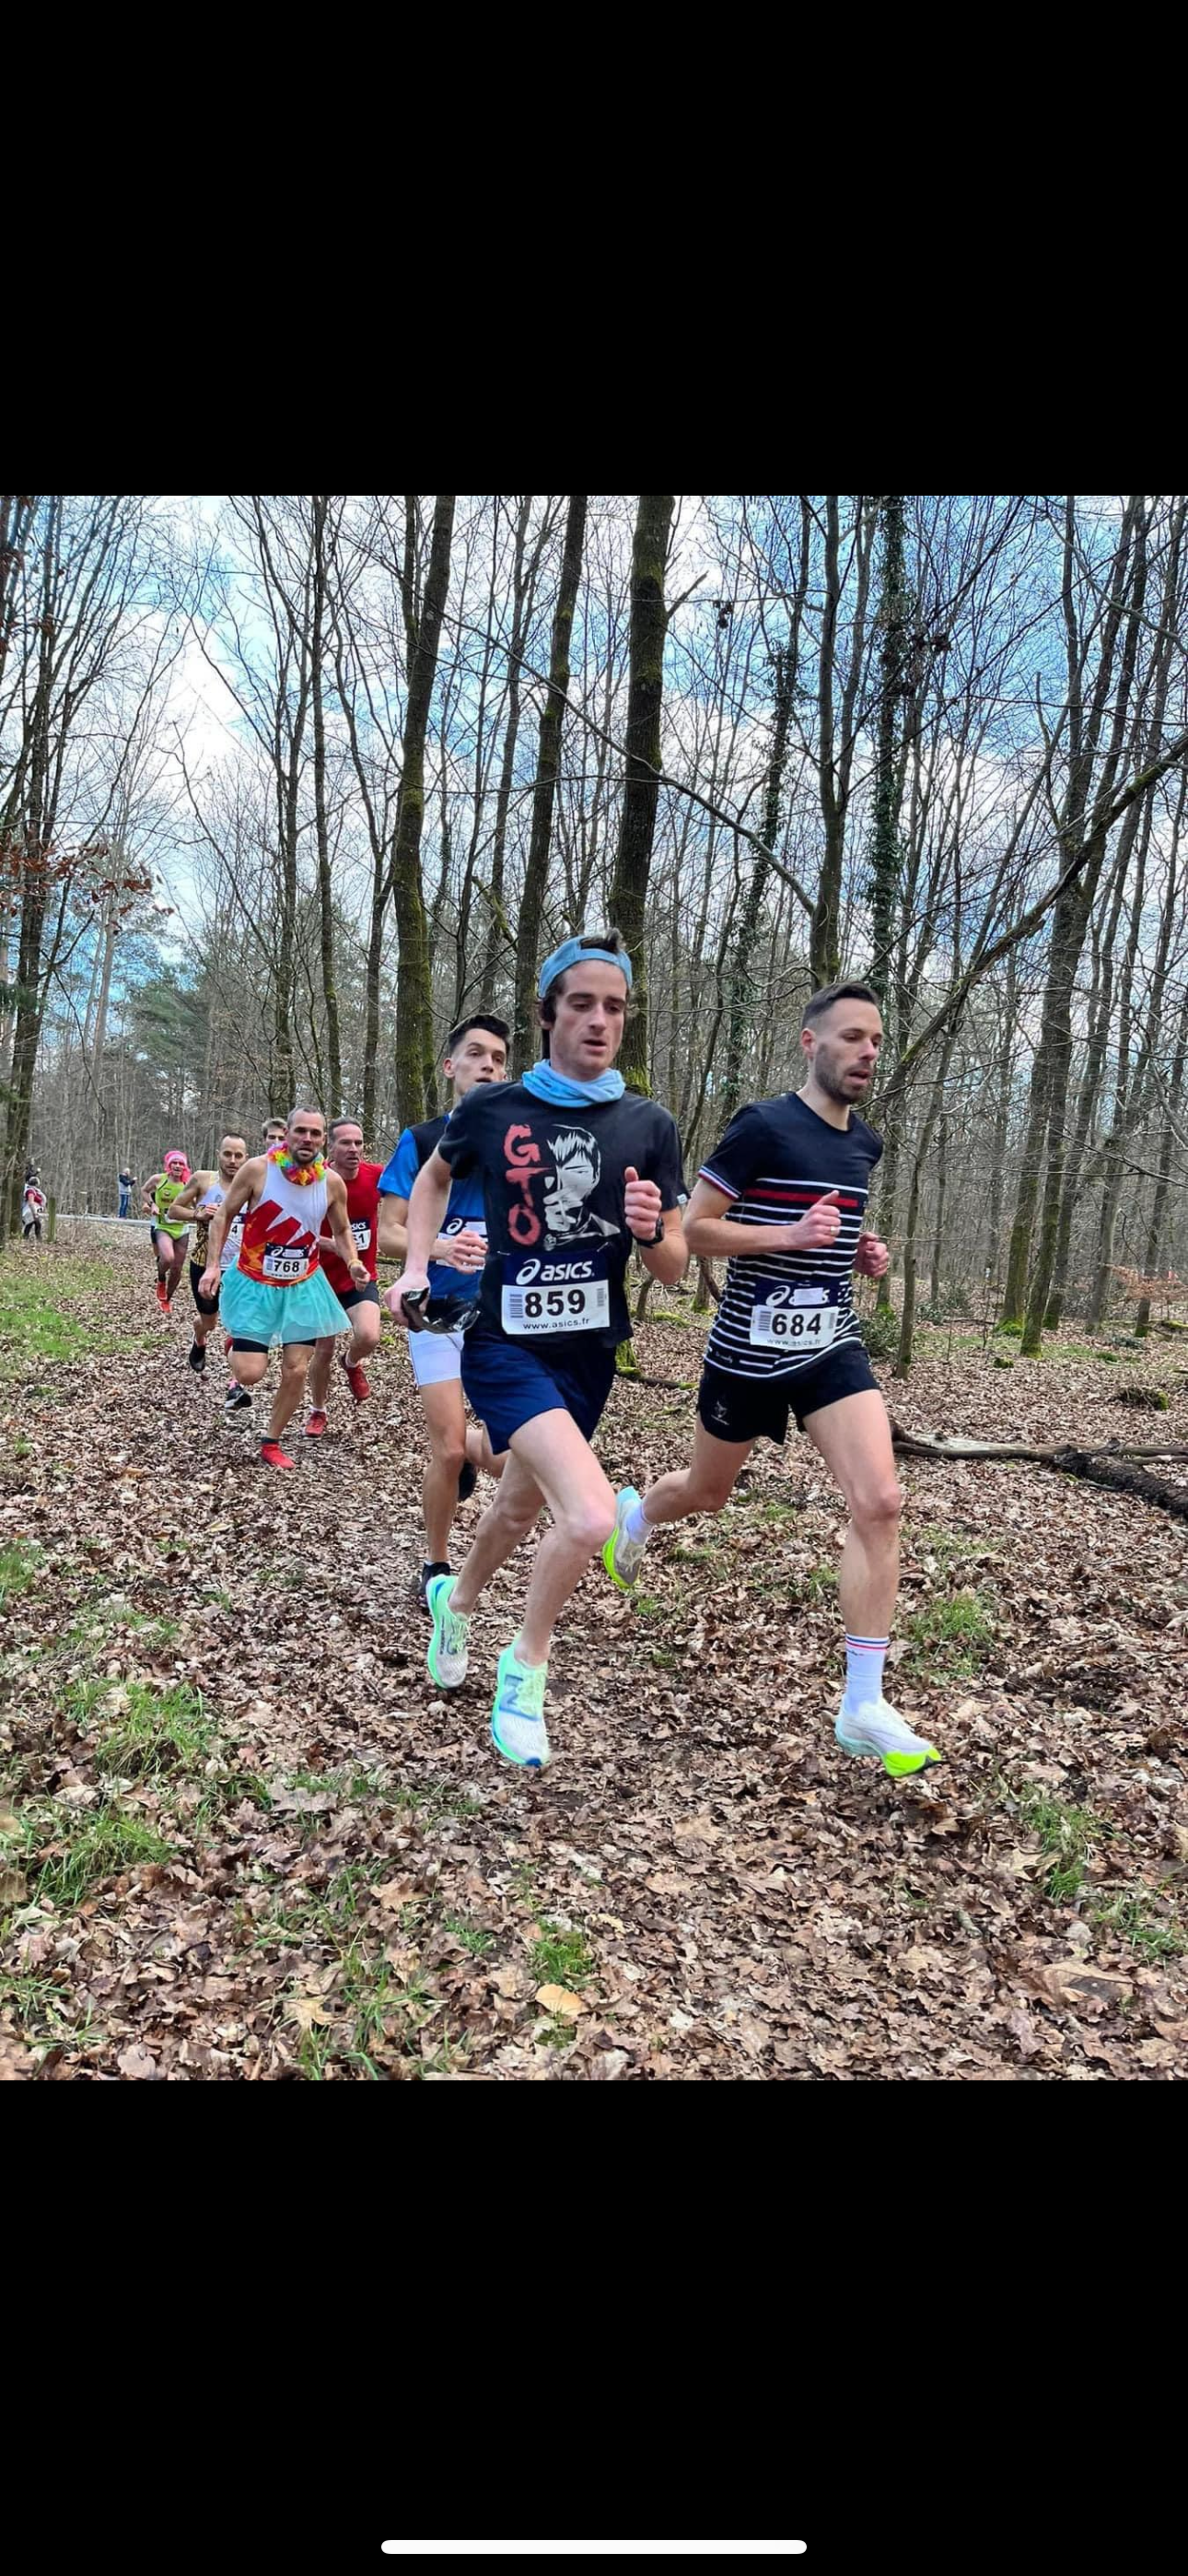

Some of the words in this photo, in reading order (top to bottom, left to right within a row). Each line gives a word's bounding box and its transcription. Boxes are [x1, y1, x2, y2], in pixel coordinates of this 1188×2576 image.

[504, 1124, 552, 1246] GTO
[274, 1259, 299, 1272] 768
[525, 1289, 586, 1317] 859
[523, 1317, 589, 1329] www.asics.fr
[772, 1313, 821, 1337] 684
